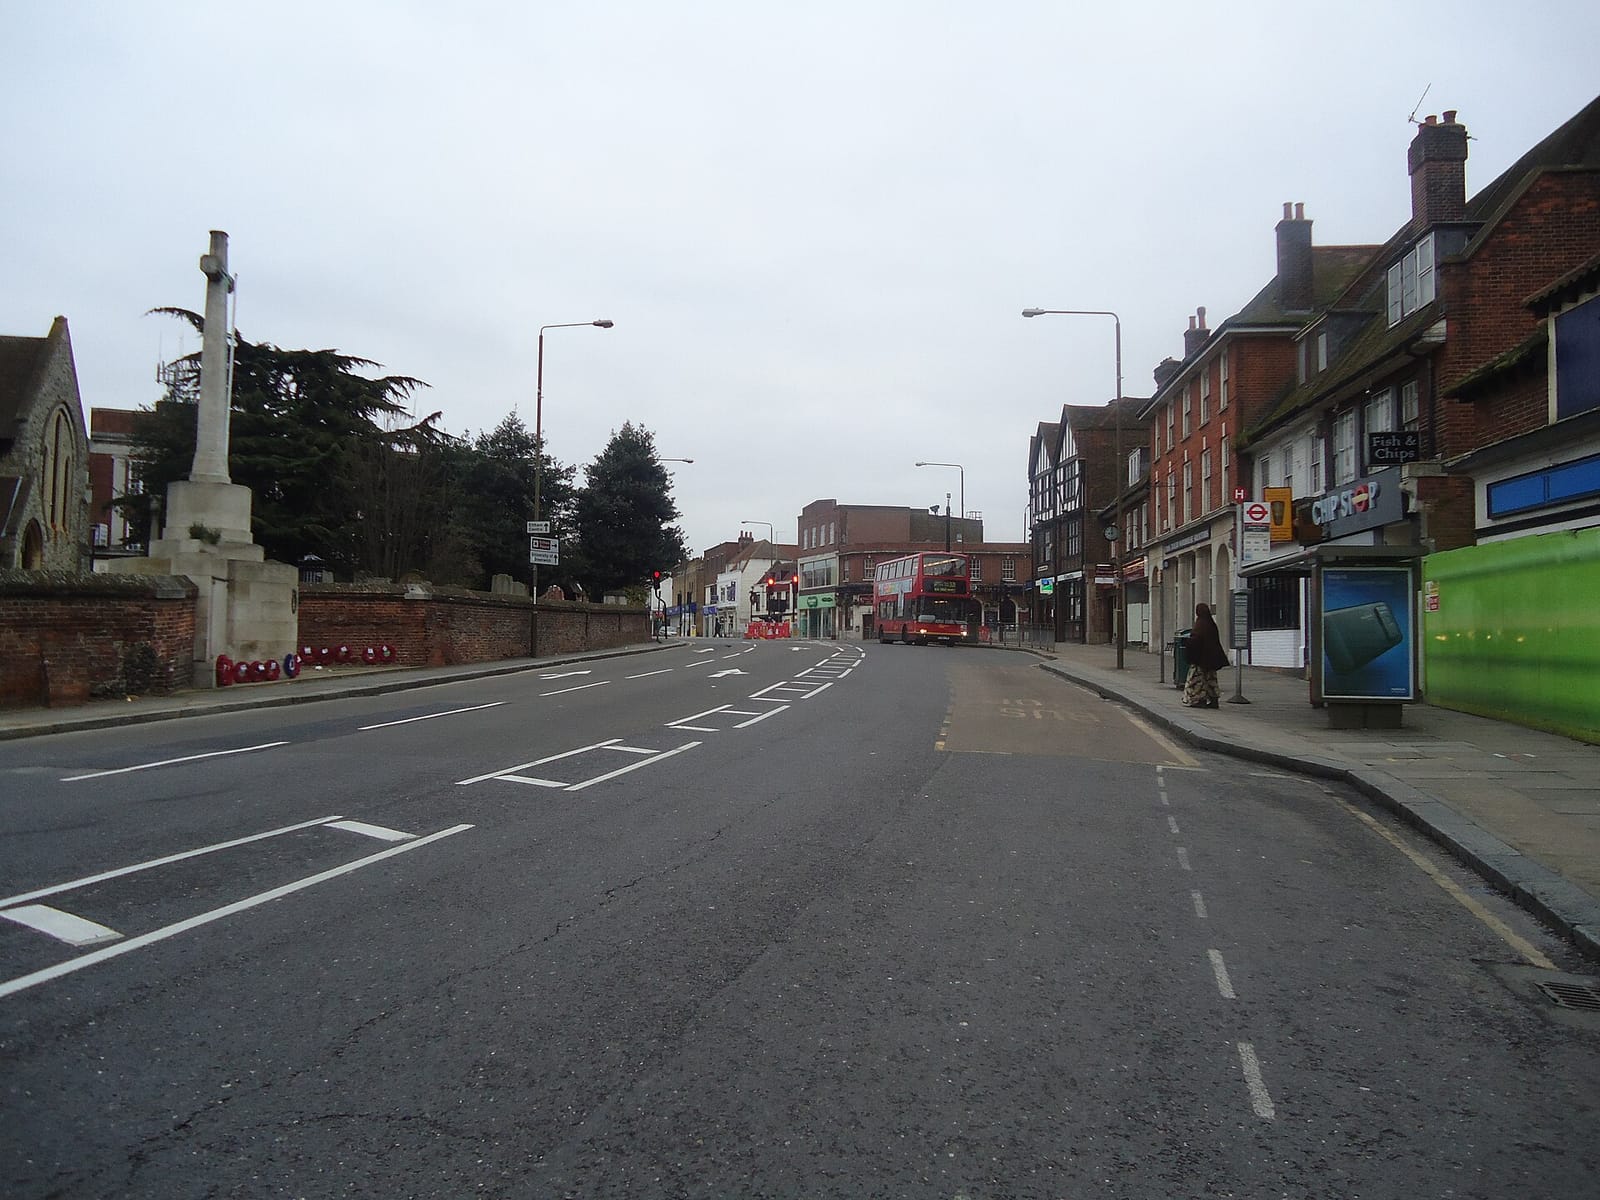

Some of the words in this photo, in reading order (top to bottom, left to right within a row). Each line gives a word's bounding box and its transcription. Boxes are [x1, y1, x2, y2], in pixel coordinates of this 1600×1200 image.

[1372, 436, 1400, 447] Fish
[1405, 435, 1416, 446] &
[1375, 447, 1415, 462] Chips
[1235, 489, 1244, 499] H
[1341, 482, 1379, 517] STOP
